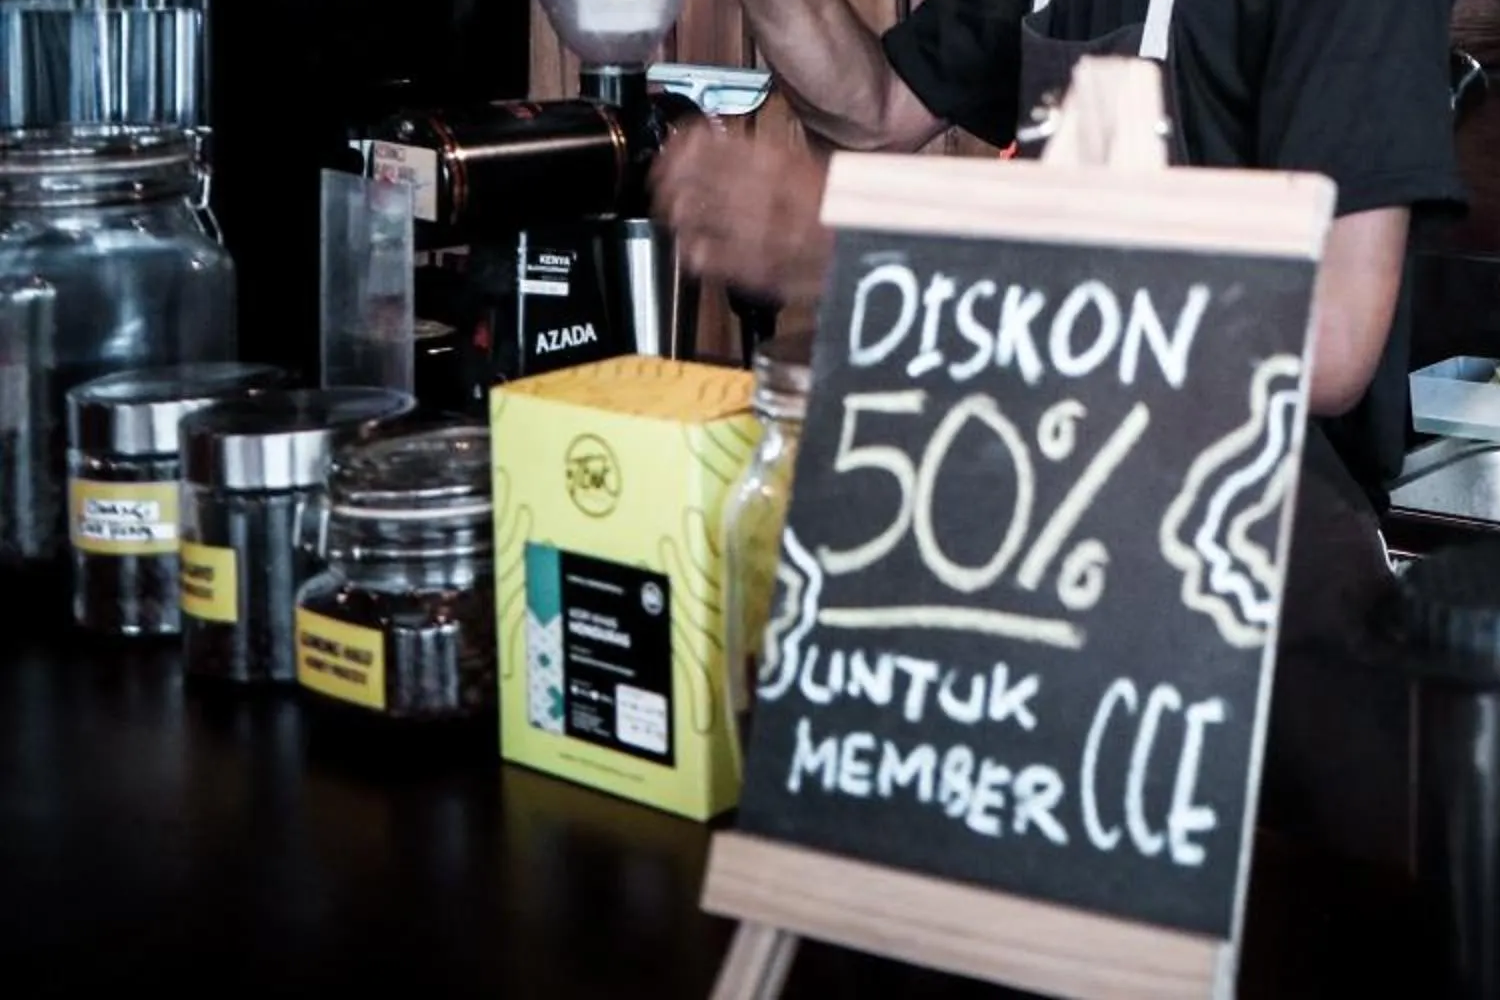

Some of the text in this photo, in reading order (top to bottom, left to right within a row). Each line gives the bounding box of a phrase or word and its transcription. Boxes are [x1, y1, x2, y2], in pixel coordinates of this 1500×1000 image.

[536, 322, 598, 355] AZADA
[847, 263, 1209, 389] DISKON
[817, 388, 1151, 609] 50%
[801, 644, 1041, 730] UNTUK
[787, 718, 1069, 844] MEMBER
